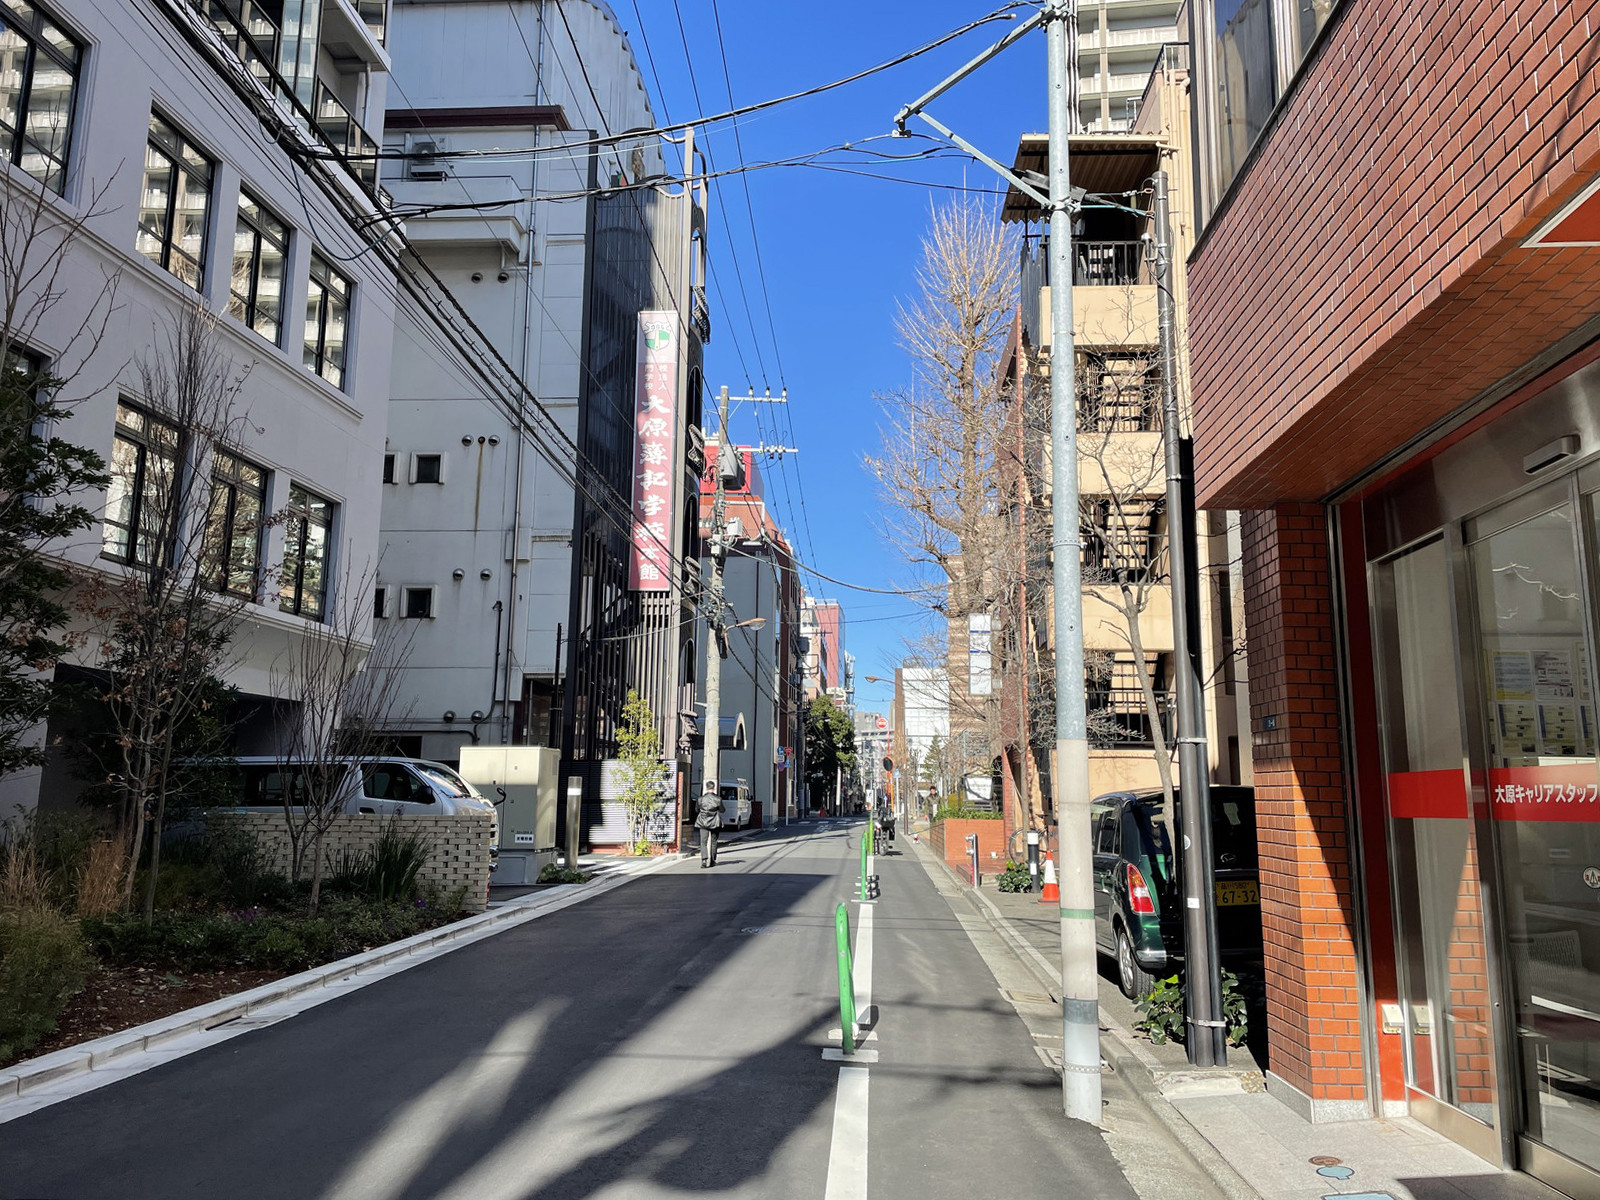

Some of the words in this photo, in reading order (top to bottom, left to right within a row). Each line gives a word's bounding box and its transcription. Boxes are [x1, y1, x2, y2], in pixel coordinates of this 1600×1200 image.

[1494, 783, 1598, 804] 大原キャリアスタッフ
[1222, 890, 1258, 904] 67-32
